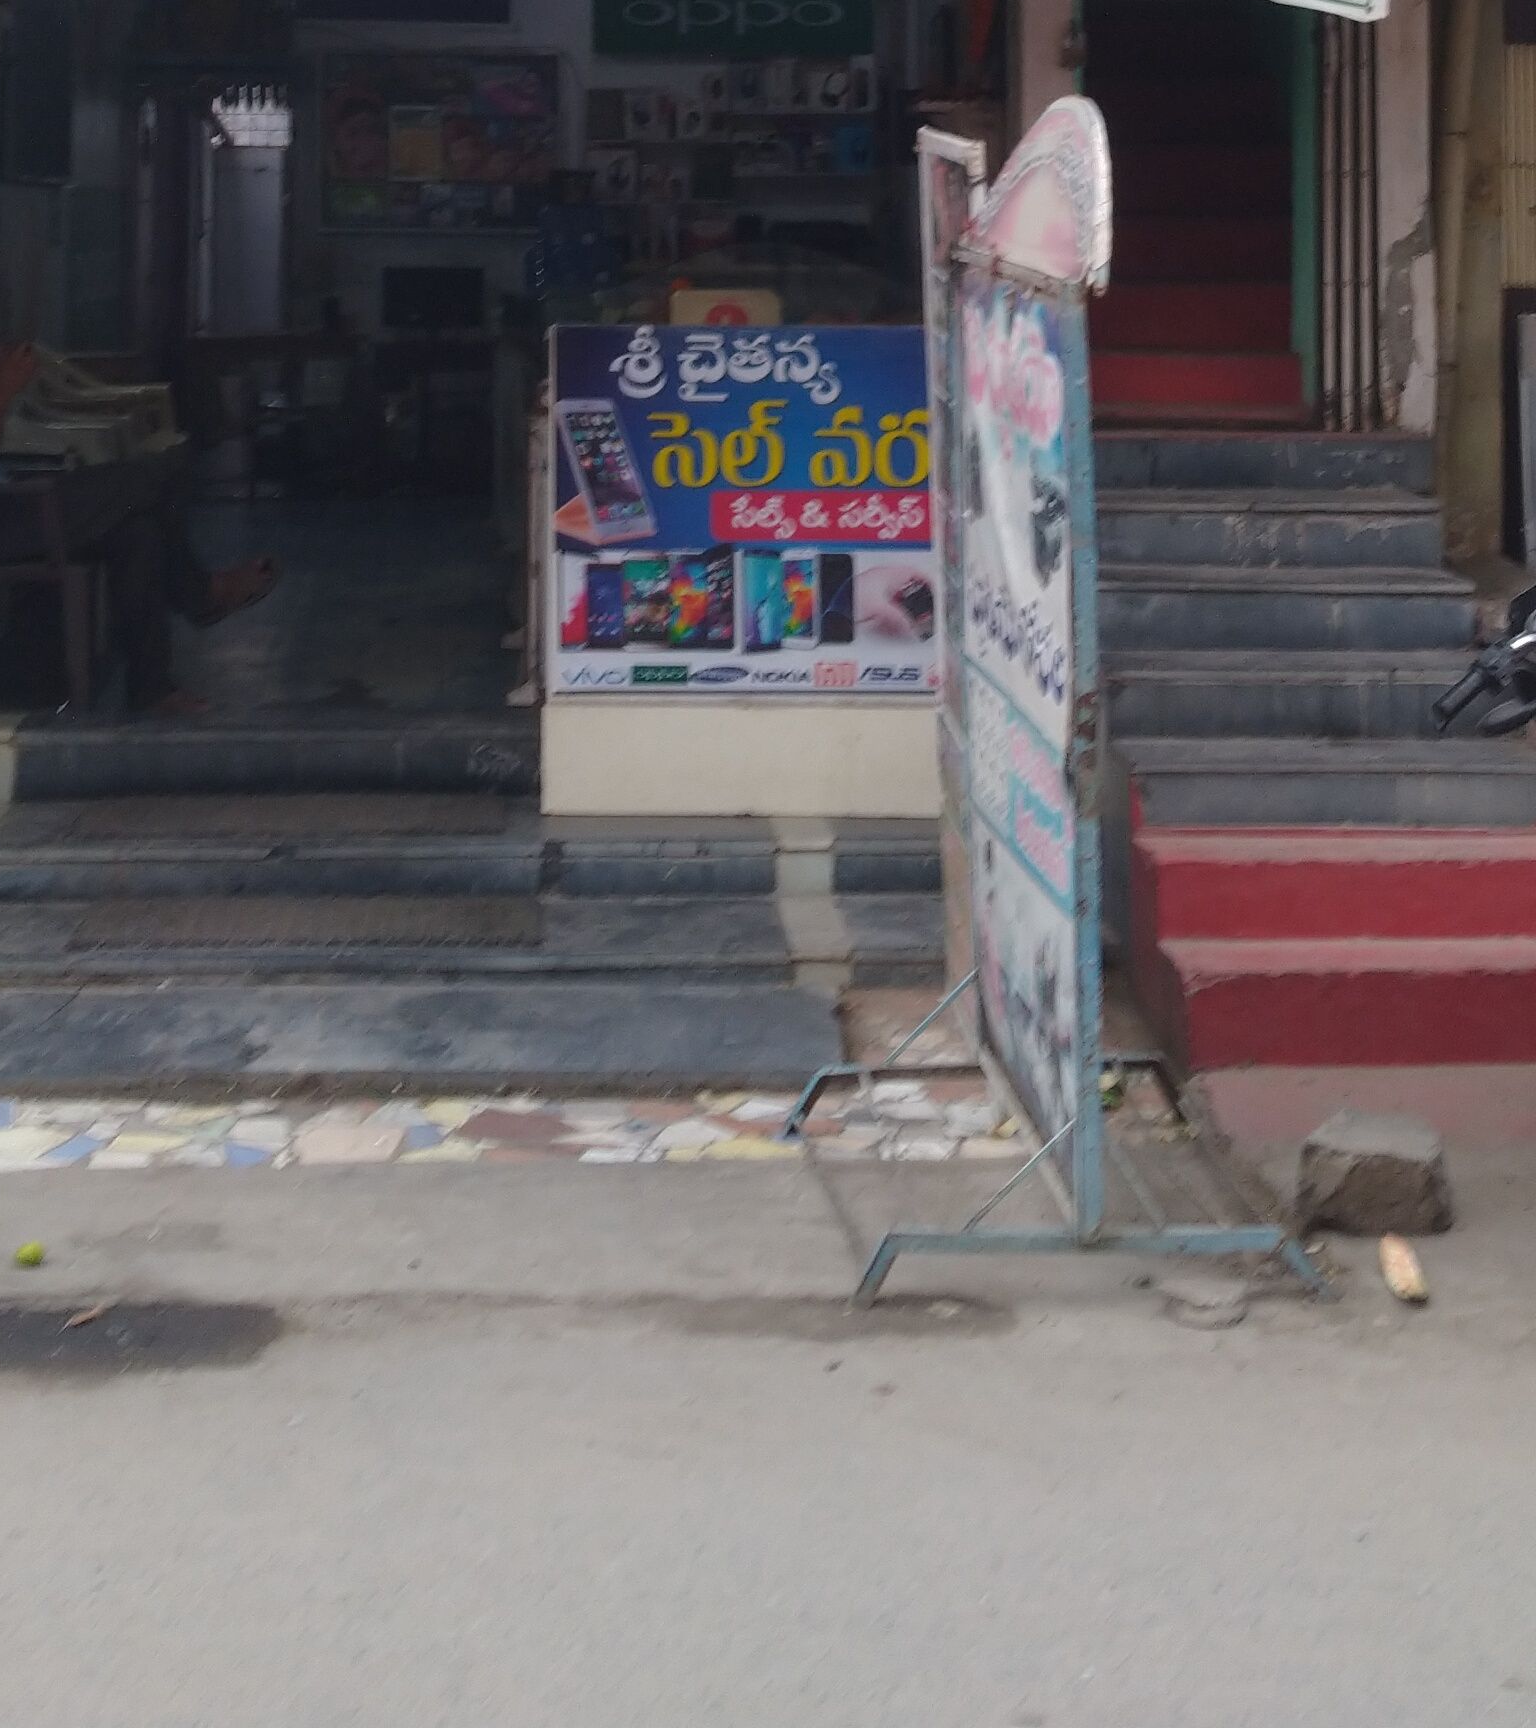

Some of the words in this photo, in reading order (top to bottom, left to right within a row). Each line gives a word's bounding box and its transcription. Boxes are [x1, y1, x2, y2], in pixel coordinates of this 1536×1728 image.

[610, 324, 668, 399] శ్రీ
[677, 331, 843, 406] చైతన్య
[647, 398, 790, 490] సెల్
